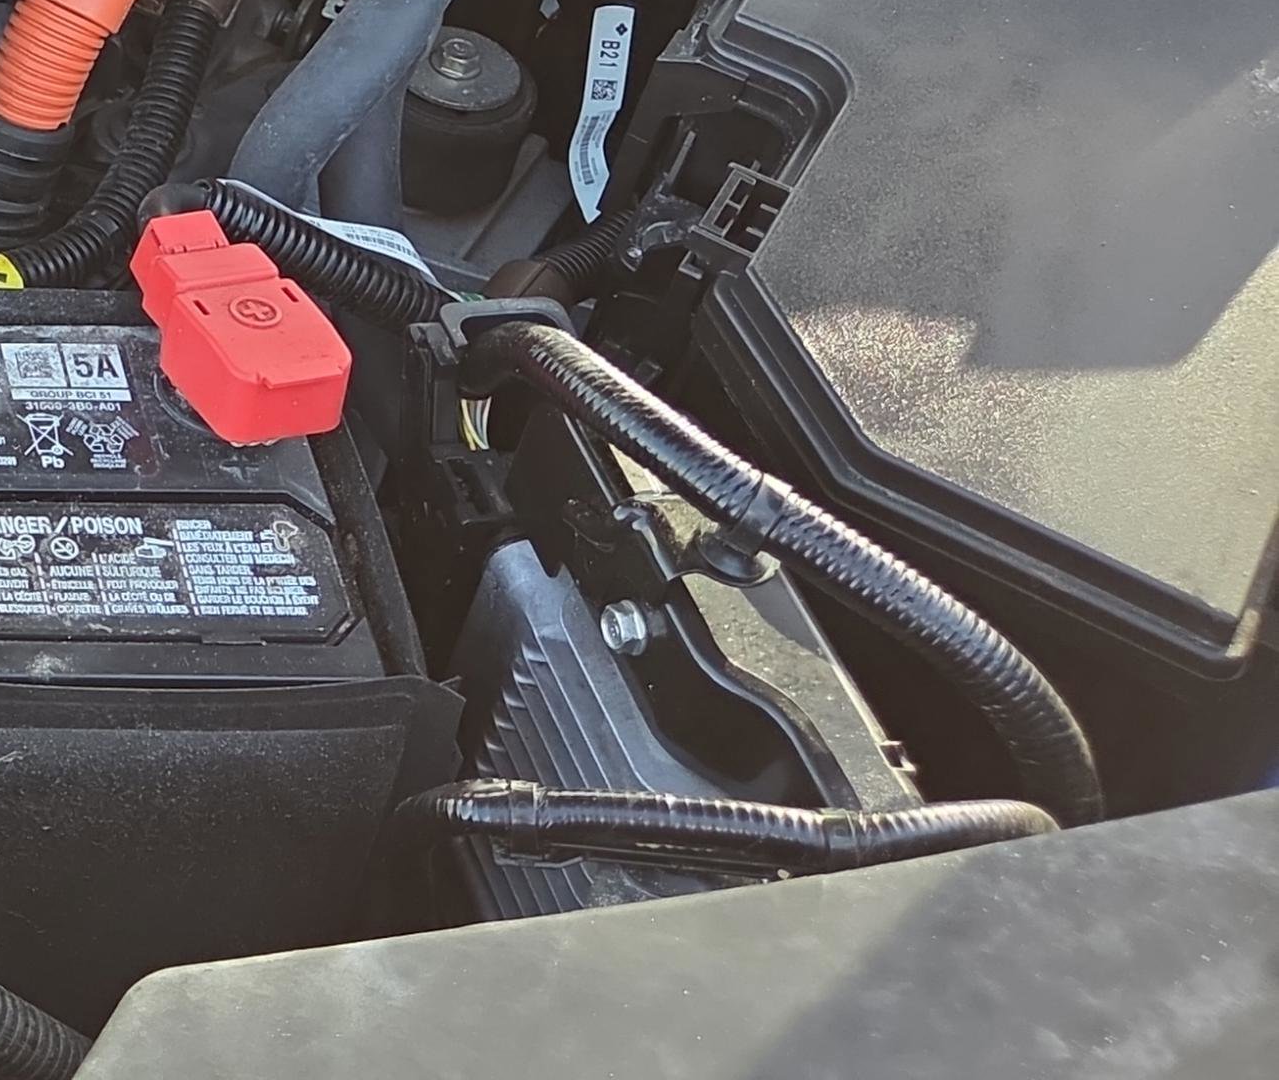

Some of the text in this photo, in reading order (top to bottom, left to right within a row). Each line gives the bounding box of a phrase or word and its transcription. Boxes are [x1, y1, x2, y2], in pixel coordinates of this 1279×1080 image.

[598, 39, 620, 68] B21
[73, 353, 119, 378] 5A
[41, 456, 65, 468] Pb
[71, 517, 144, 535] POISON
[49, 566, 94, 577] AUCUNE
[102, 566, 161, 578] SULFURIQUE
